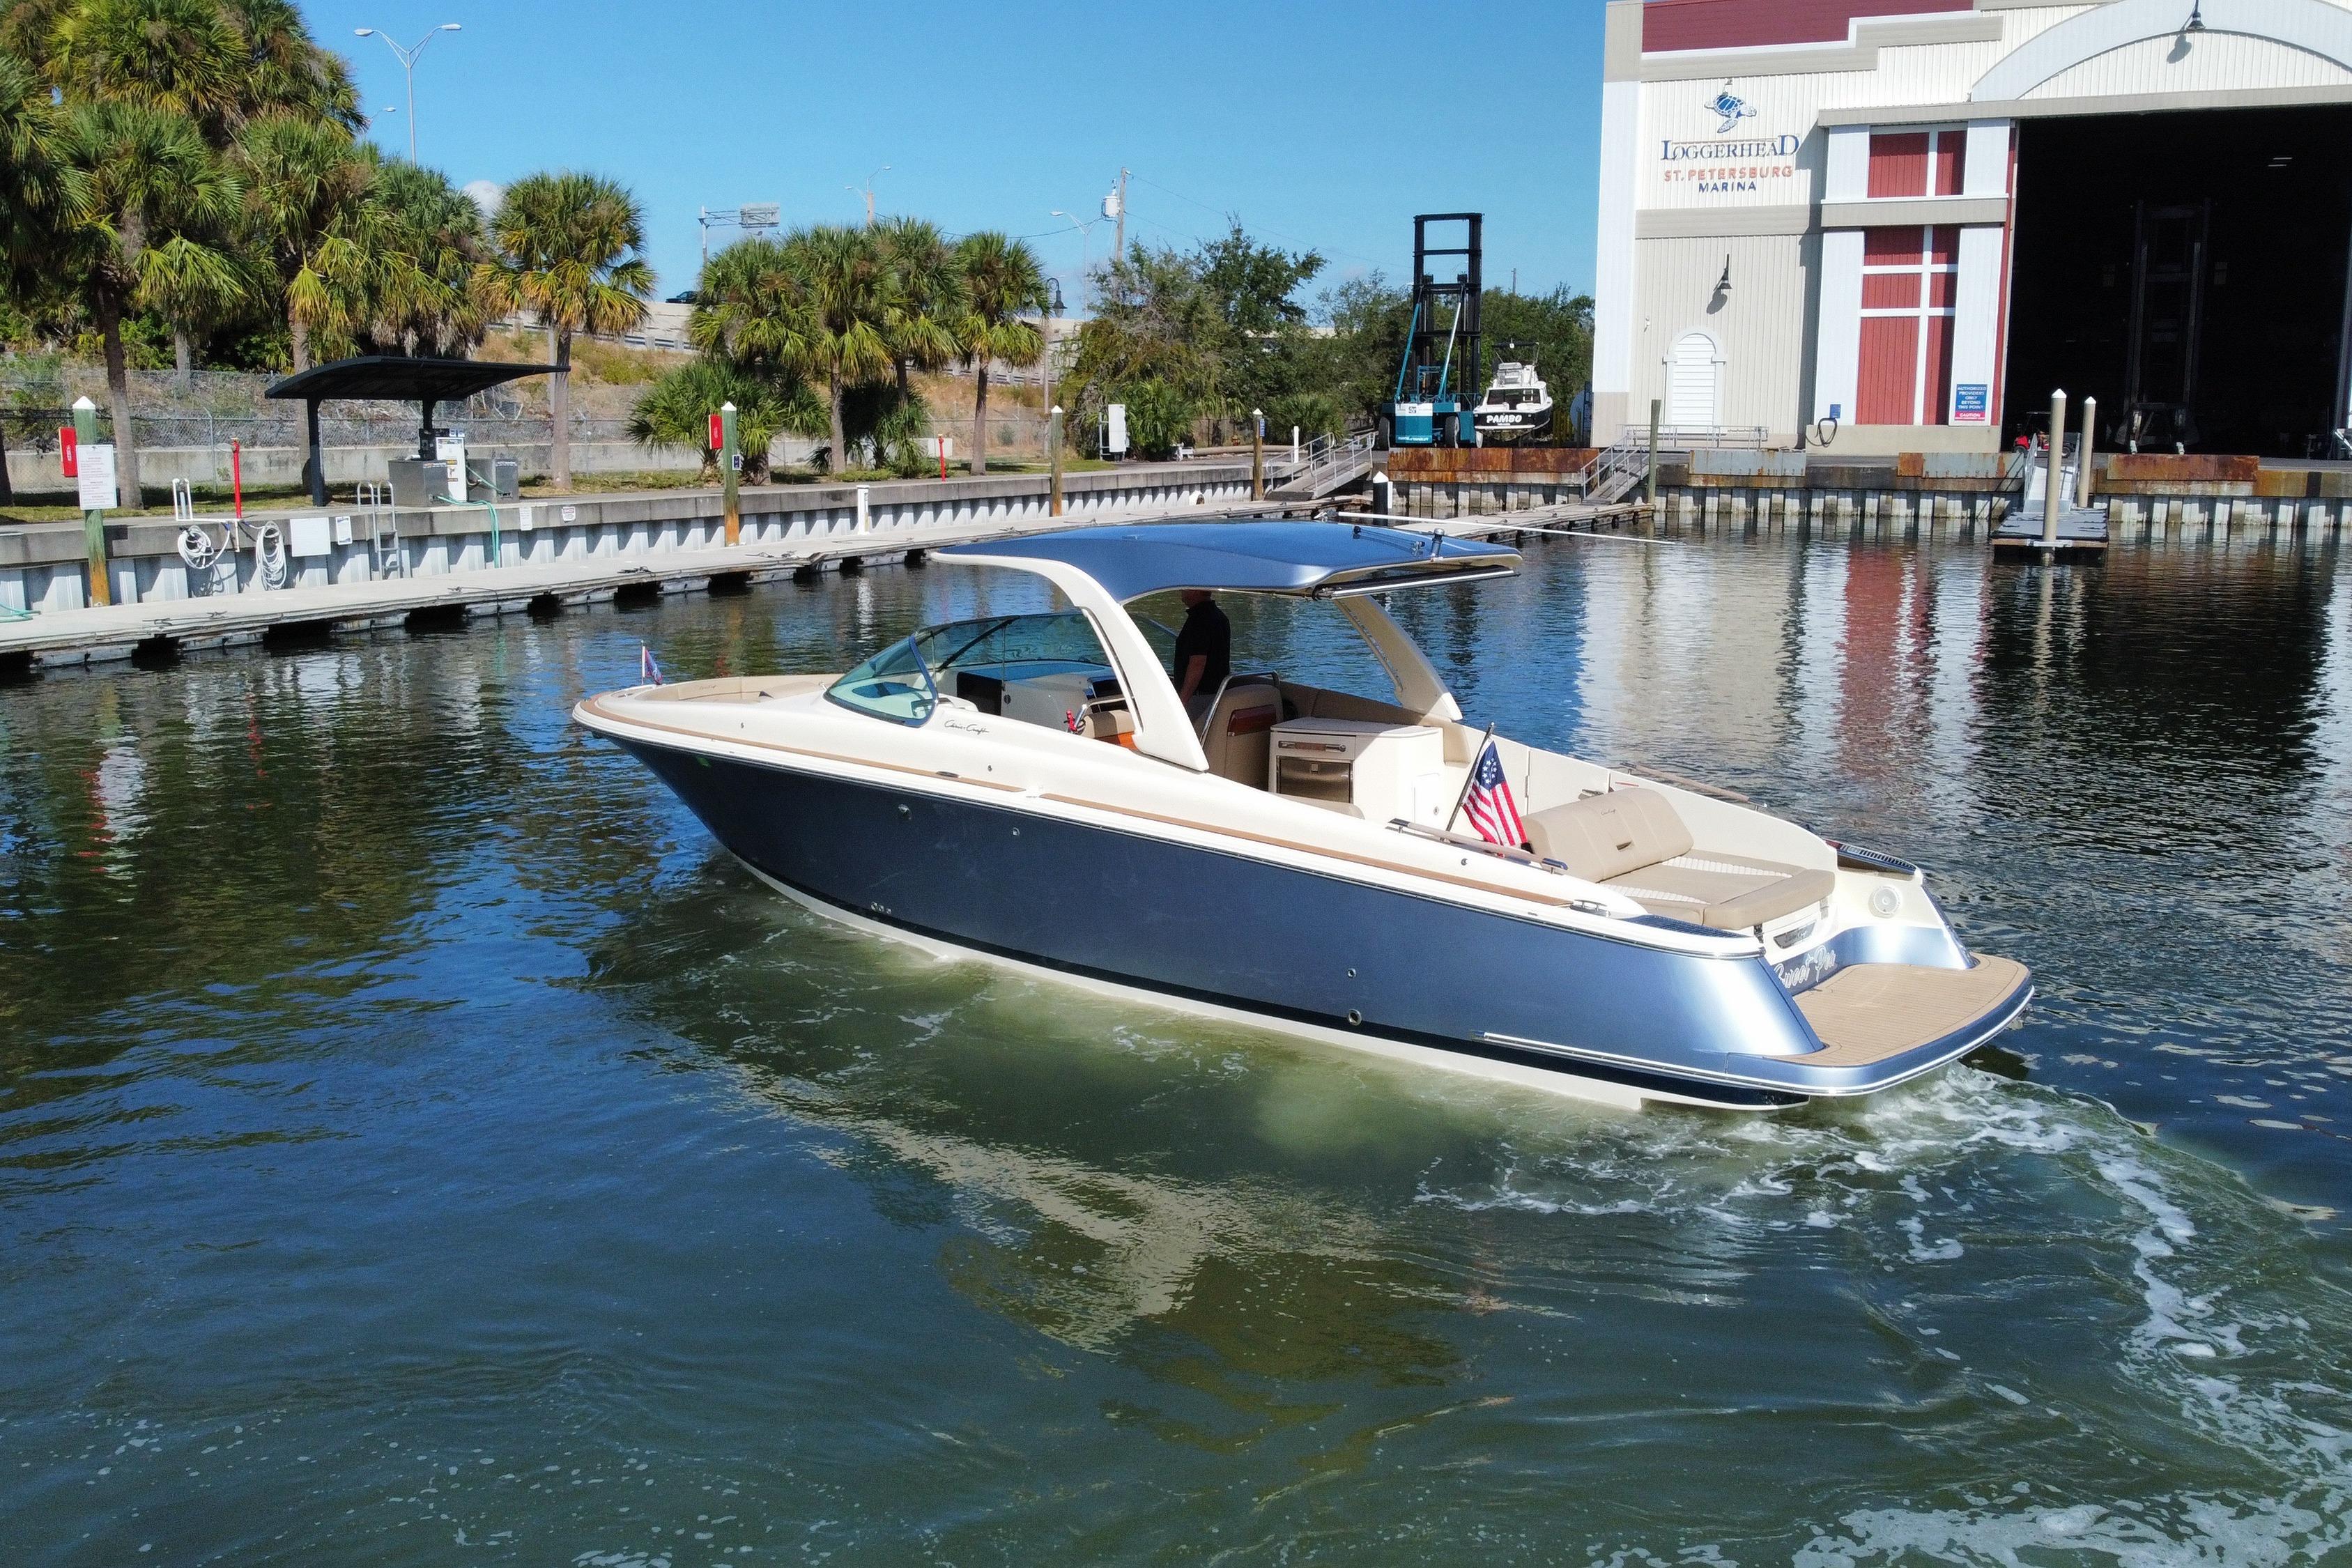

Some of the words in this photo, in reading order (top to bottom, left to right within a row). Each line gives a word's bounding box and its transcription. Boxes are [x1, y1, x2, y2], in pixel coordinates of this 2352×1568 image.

[1661, 134, 1799, 161] LOGGERHEAD
[1664, 169, 1684, 182] ST.
[1688, 165, 1793, 181] PETERSBURG
[1698, 181, 1757, 193] MARINA
[1486, 414, 1523, 424] PAMBO
